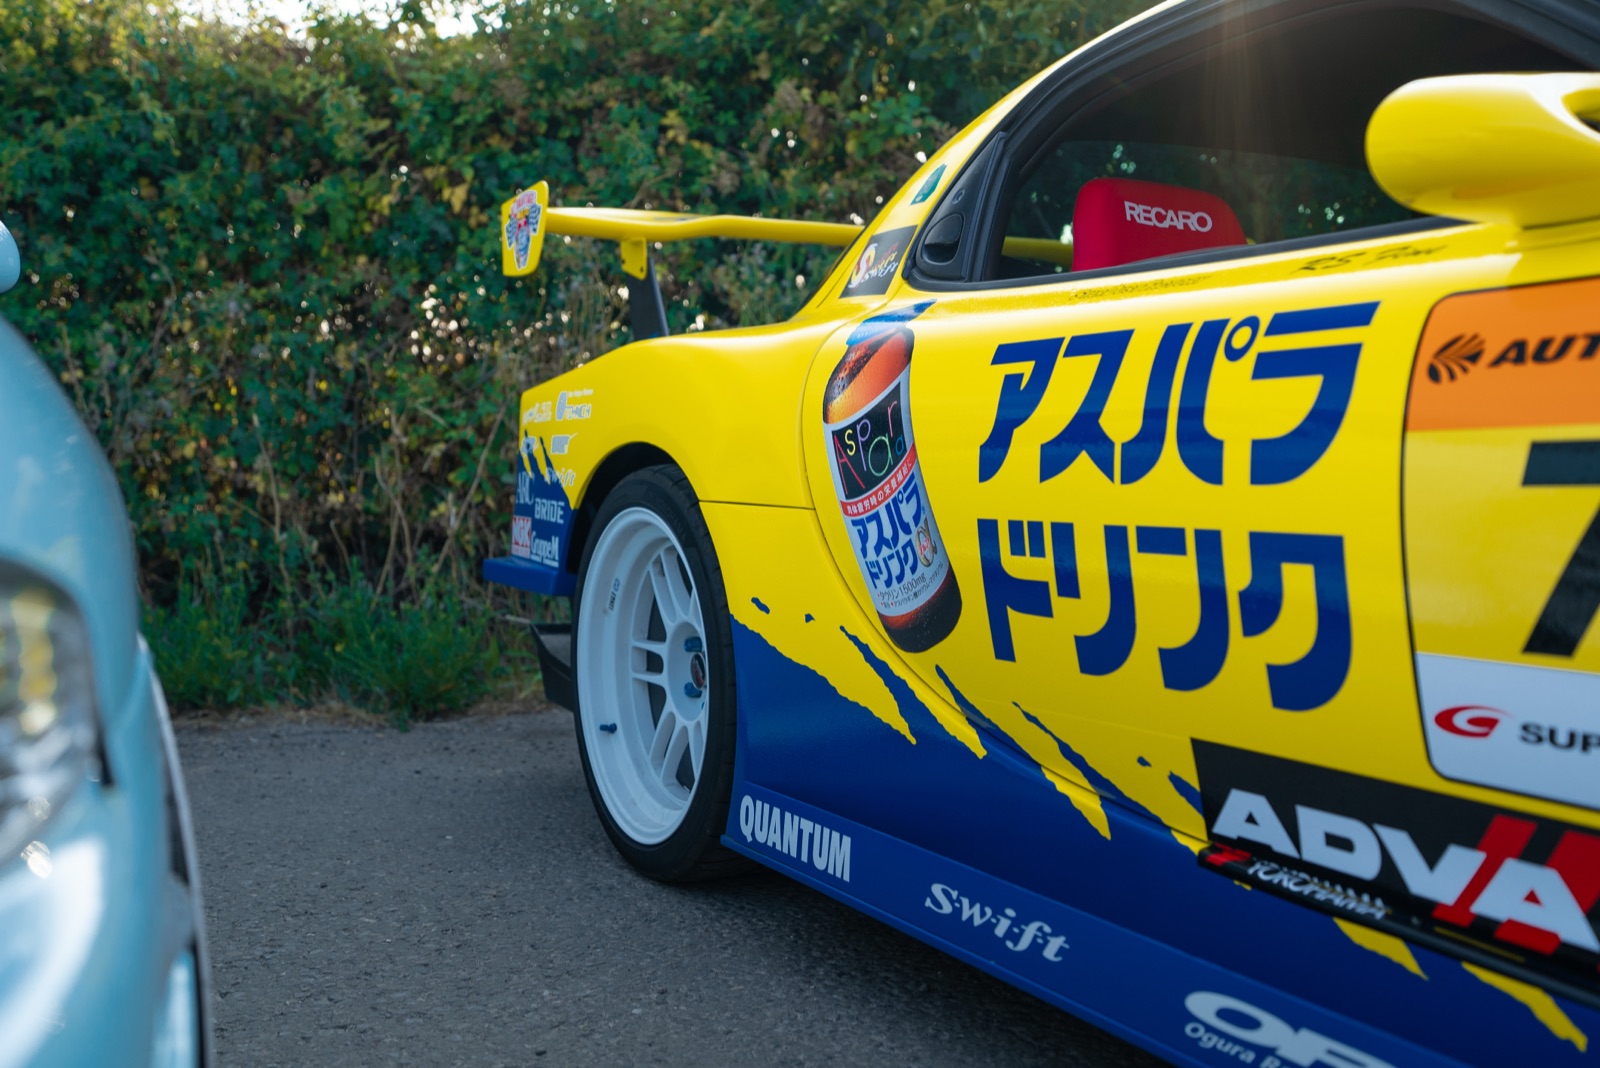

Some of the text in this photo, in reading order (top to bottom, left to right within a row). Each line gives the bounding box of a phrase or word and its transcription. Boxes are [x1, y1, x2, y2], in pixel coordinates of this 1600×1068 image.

[1124, 201, 1212, 233] RECARO
[1487, 332, 1600, 368] AUT
[978, 300, 1382, 486] アスパラ
[513, 517, 531, 548] NGK
[534, 497, 565, 524] BRIDE
[851, 472, 921, 560] アスパラ
[865, 538, 918, 589] ドリンク
[1522, 440, 1600, 658] 7
[977, 518, 1352, 712] ドリンク
[1518, 722, 1600, 755] SUP
[739, 795, 851, 882] QUANTUM
[1212, 788, 1600, 953] ADVA
[925, 883, 1070, 962] Swift
[1185, 1022, 1256, 1064] Ogura
